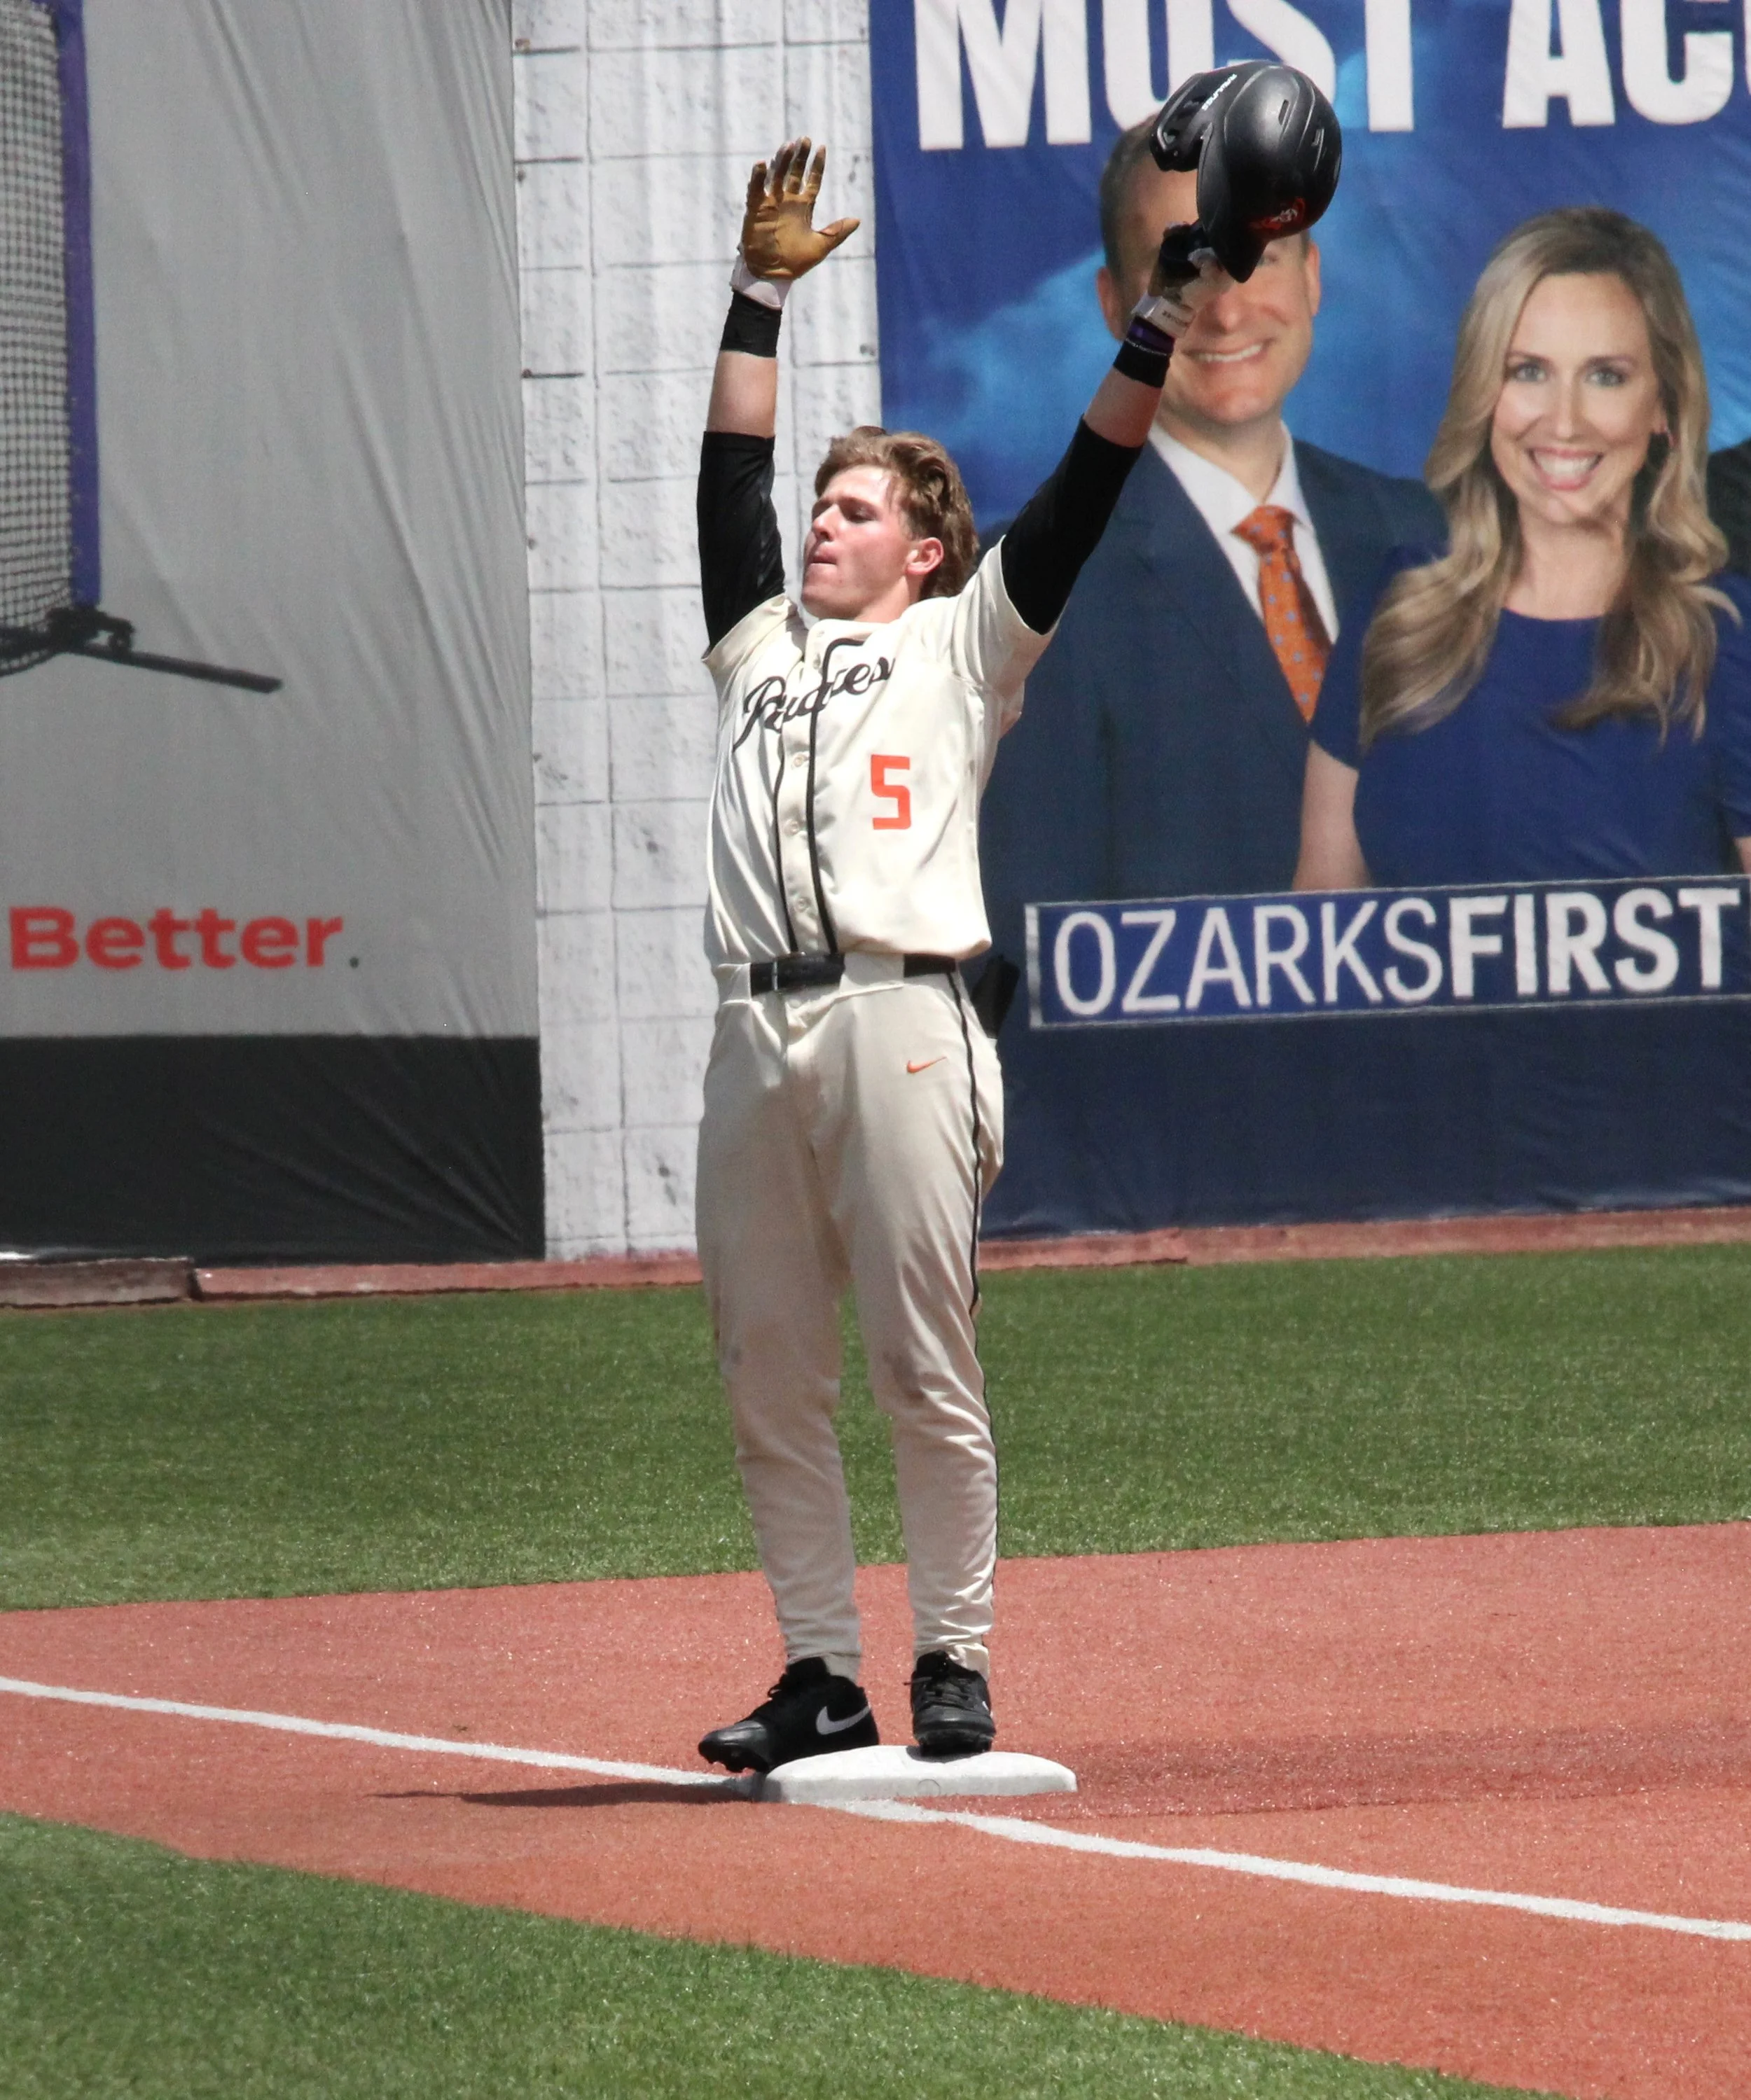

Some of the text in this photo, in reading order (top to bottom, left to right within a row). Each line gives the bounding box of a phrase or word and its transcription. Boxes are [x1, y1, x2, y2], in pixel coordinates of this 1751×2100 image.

[1502, 0, 1751, 128] AC
[870, 754, 911, 830] 5
[1053, 887, 1741, 1017] OZARKSFIRST
